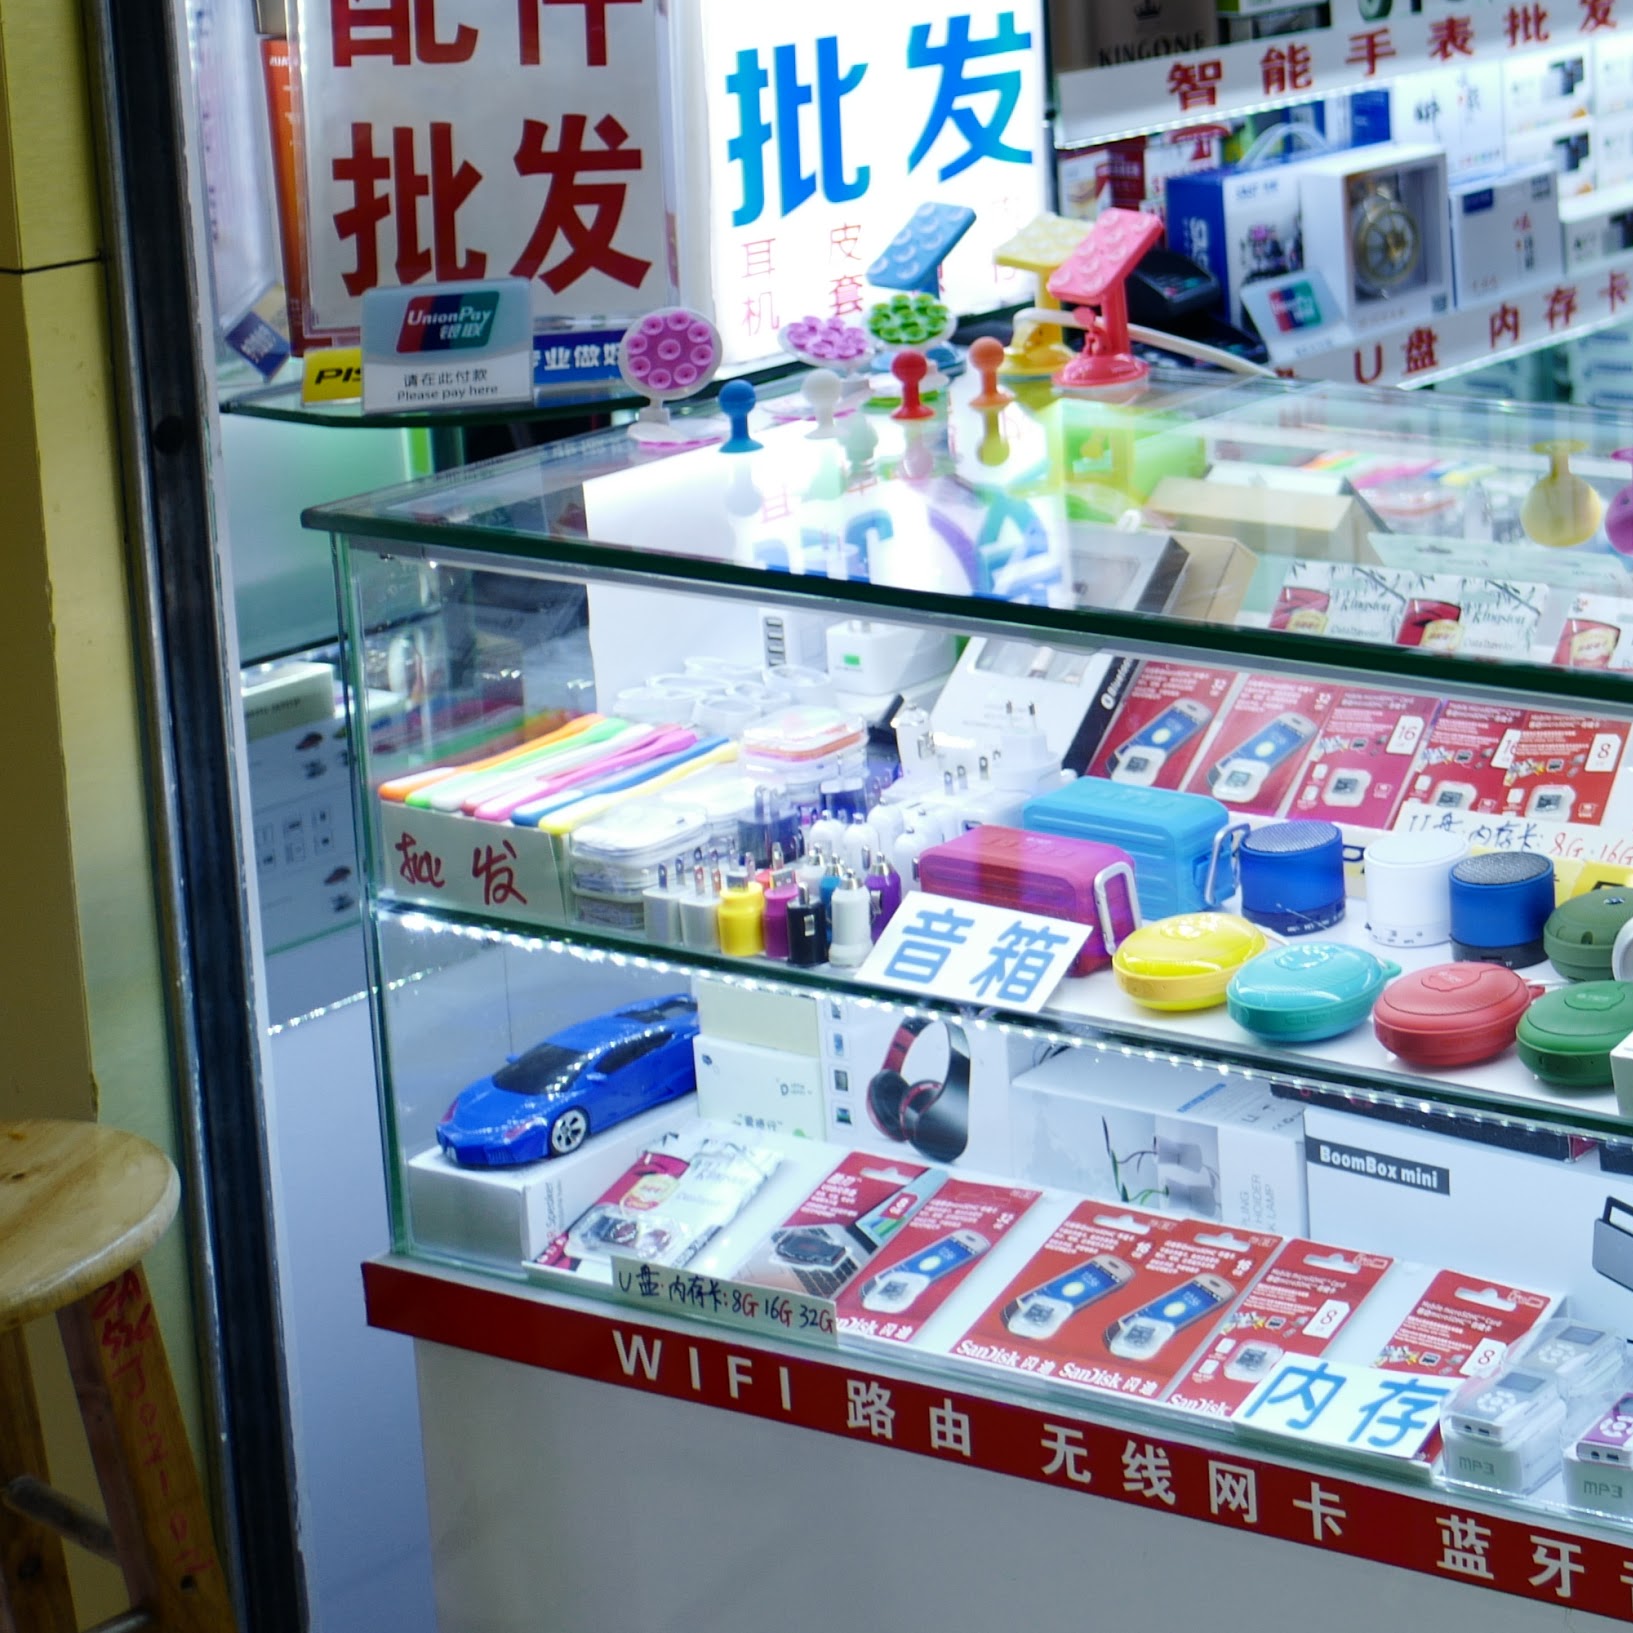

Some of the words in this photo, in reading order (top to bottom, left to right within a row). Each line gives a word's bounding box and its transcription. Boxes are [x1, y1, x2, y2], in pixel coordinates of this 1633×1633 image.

[726, 9, 1035, 228] 批发
[332, 113, 653, 299] 批发
[407, 305, 493, 328] UnionPay
[1353, 325, 1440, 385] U盘
[1488, 270, 1633, 350] 内存卡
[397, 387, 438, 402] Please
[441, 387, 467, 402] pay
[469, 384, 499, 398] here
[403, 369, 489, 388] 请在此付款
[1598, 742, 1610, 759] 8
[396, 834, 528, 907] 批发
[884, 905, 1070, 1005] 音箱
[1318, 1144, 1399, 1181] BoomBox
[1400, 1165, 1439, 1189] mini
[731, 1289, 760, 1318] 8G
[764, 1296, 793, 1328] 16G
[799, 1304, 834, 1334] 32G
[1320, 1308, 1338, 1327] 8
[956, 1339, 1020, 1367] SanDisk
[1058, 1361, 1123, 1391] SanDisk
[1165, 1393, 1233, 1417] SanDisk
[1242, 1360, 1450, 1450] 内存
[611, 1329, 793, 1411] WIFI
[845, 1378, 973, 1458] 路由
[1040, 1422, 1348, 1541] 无线网卡
